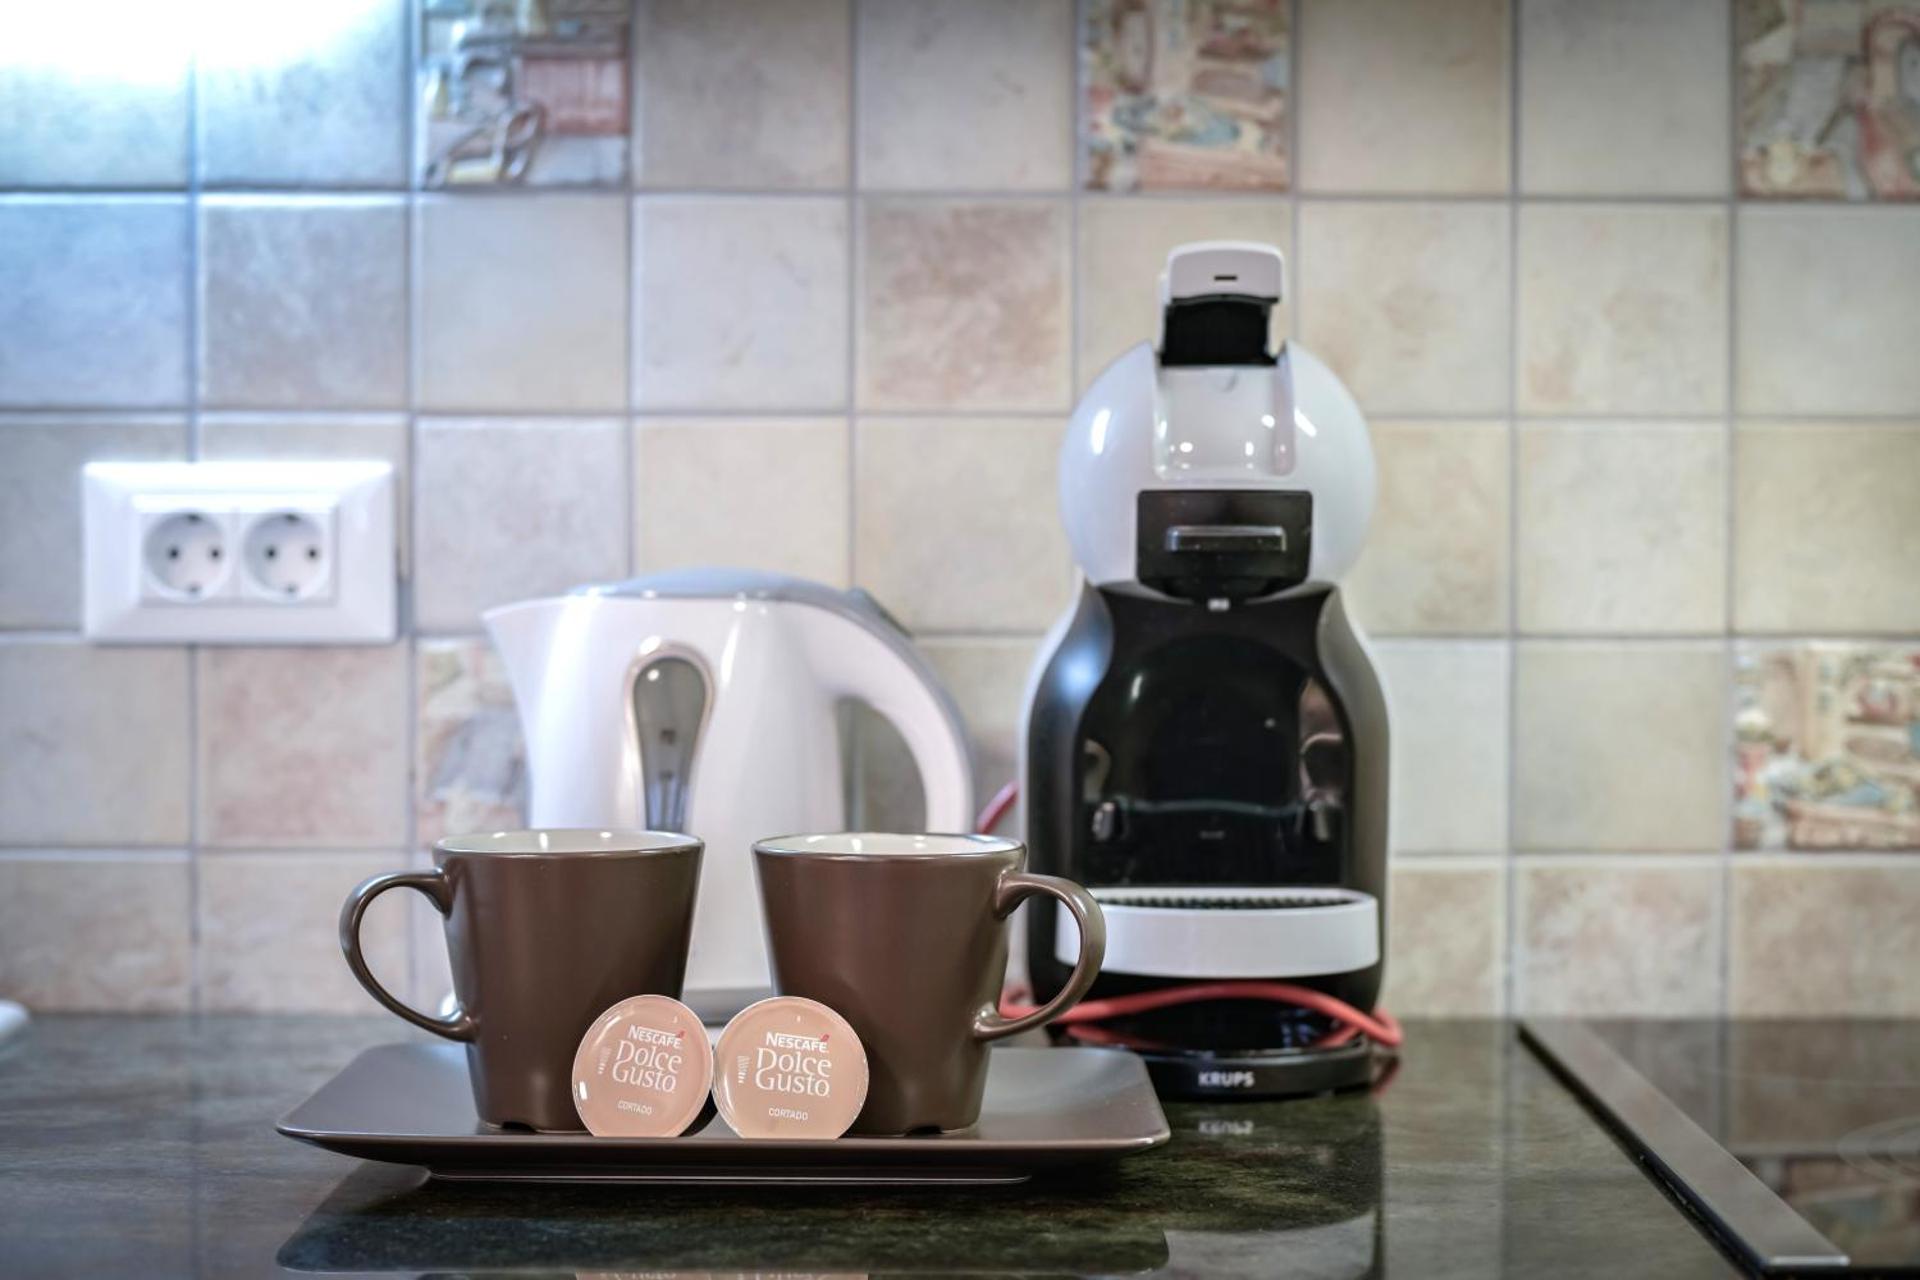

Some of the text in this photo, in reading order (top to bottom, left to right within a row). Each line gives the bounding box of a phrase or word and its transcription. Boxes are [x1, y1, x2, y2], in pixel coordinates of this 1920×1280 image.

[616, 1040, 682, 1073] Dolce
[757, 1048, 832, 1077] Dolce
[613, 1062, 676, 1092] Gusto
[755, 1069, 830, 1097] Gusto
[1199, 1072, 1254, 1087] KRUPS
[617, 1099, 652, 1115] CORTADO
[768, 1107, 809, 1121] CORTADO
